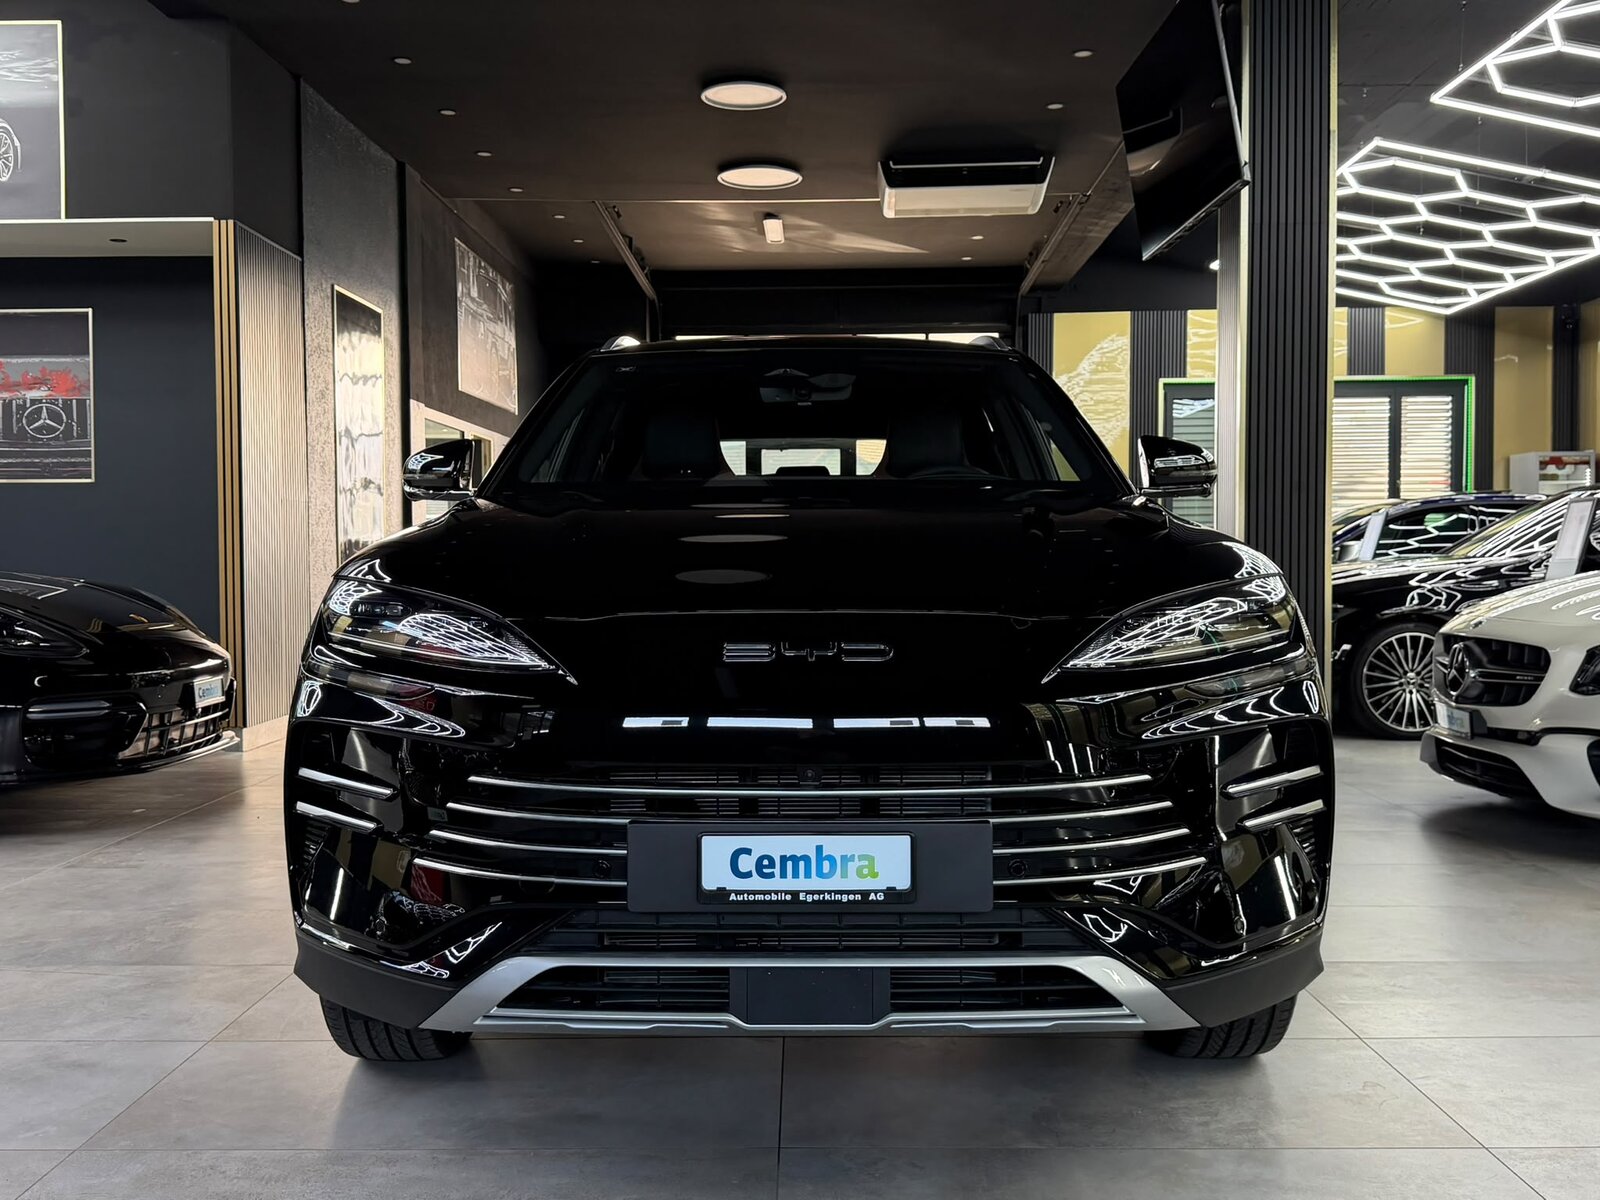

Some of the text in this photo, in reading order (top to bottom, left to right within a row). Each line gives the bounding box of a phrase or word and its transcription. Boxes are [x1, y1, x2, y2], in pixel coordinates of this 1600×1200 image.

[722, 641, 894, 662] BYD
[729, 844, 880, 880] Cembra
[729, 892, 885, 902] Automobile Egerkingen AG
